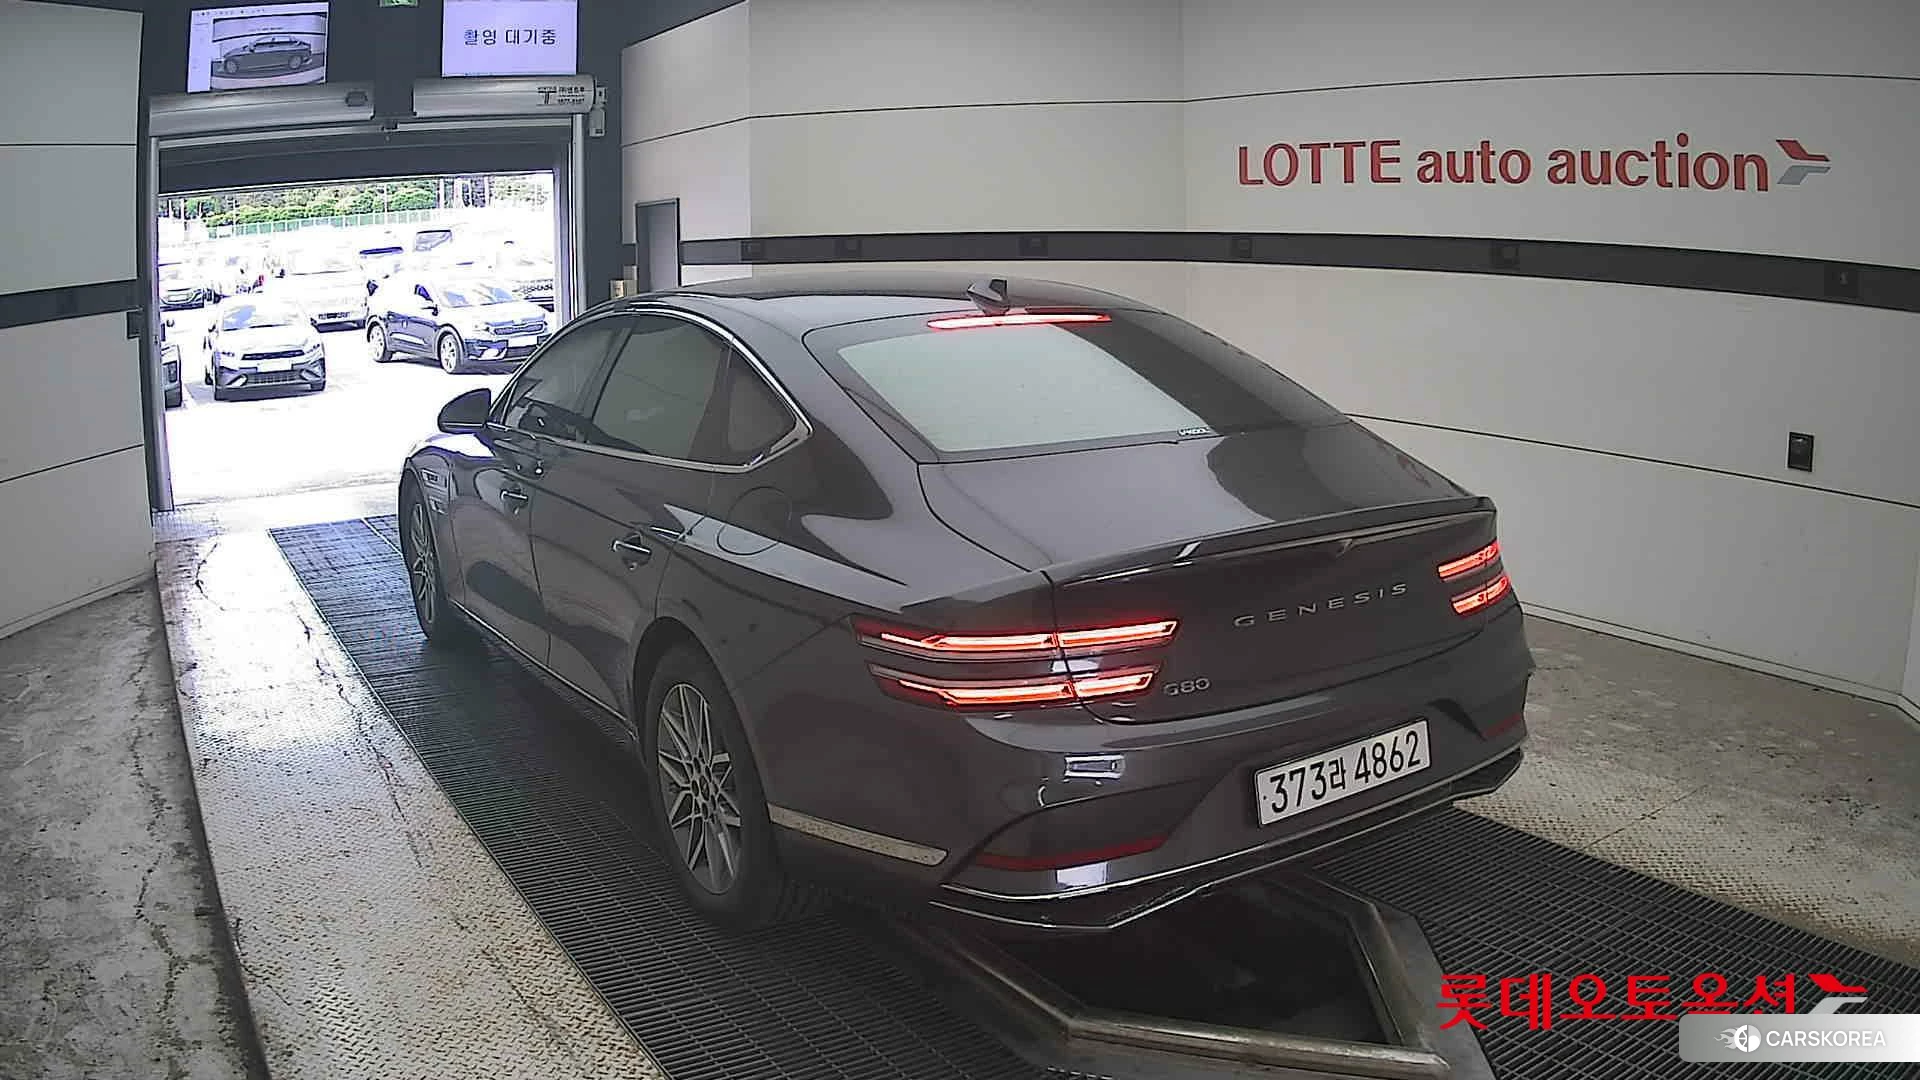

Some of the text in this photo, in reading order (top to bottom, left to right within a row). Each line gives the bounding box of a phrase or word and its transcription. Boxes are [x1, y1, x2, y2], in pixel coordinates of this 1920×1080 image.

[505, 29, 557, 46] 대기중
[1238, 132, 1769, 192] LOTTE auto auction
[1233, 583, 1407, 627] GENESIS
[1164, 678, 1210, 696] G80
[1269, 730, 1421, 813] 373라 4862
